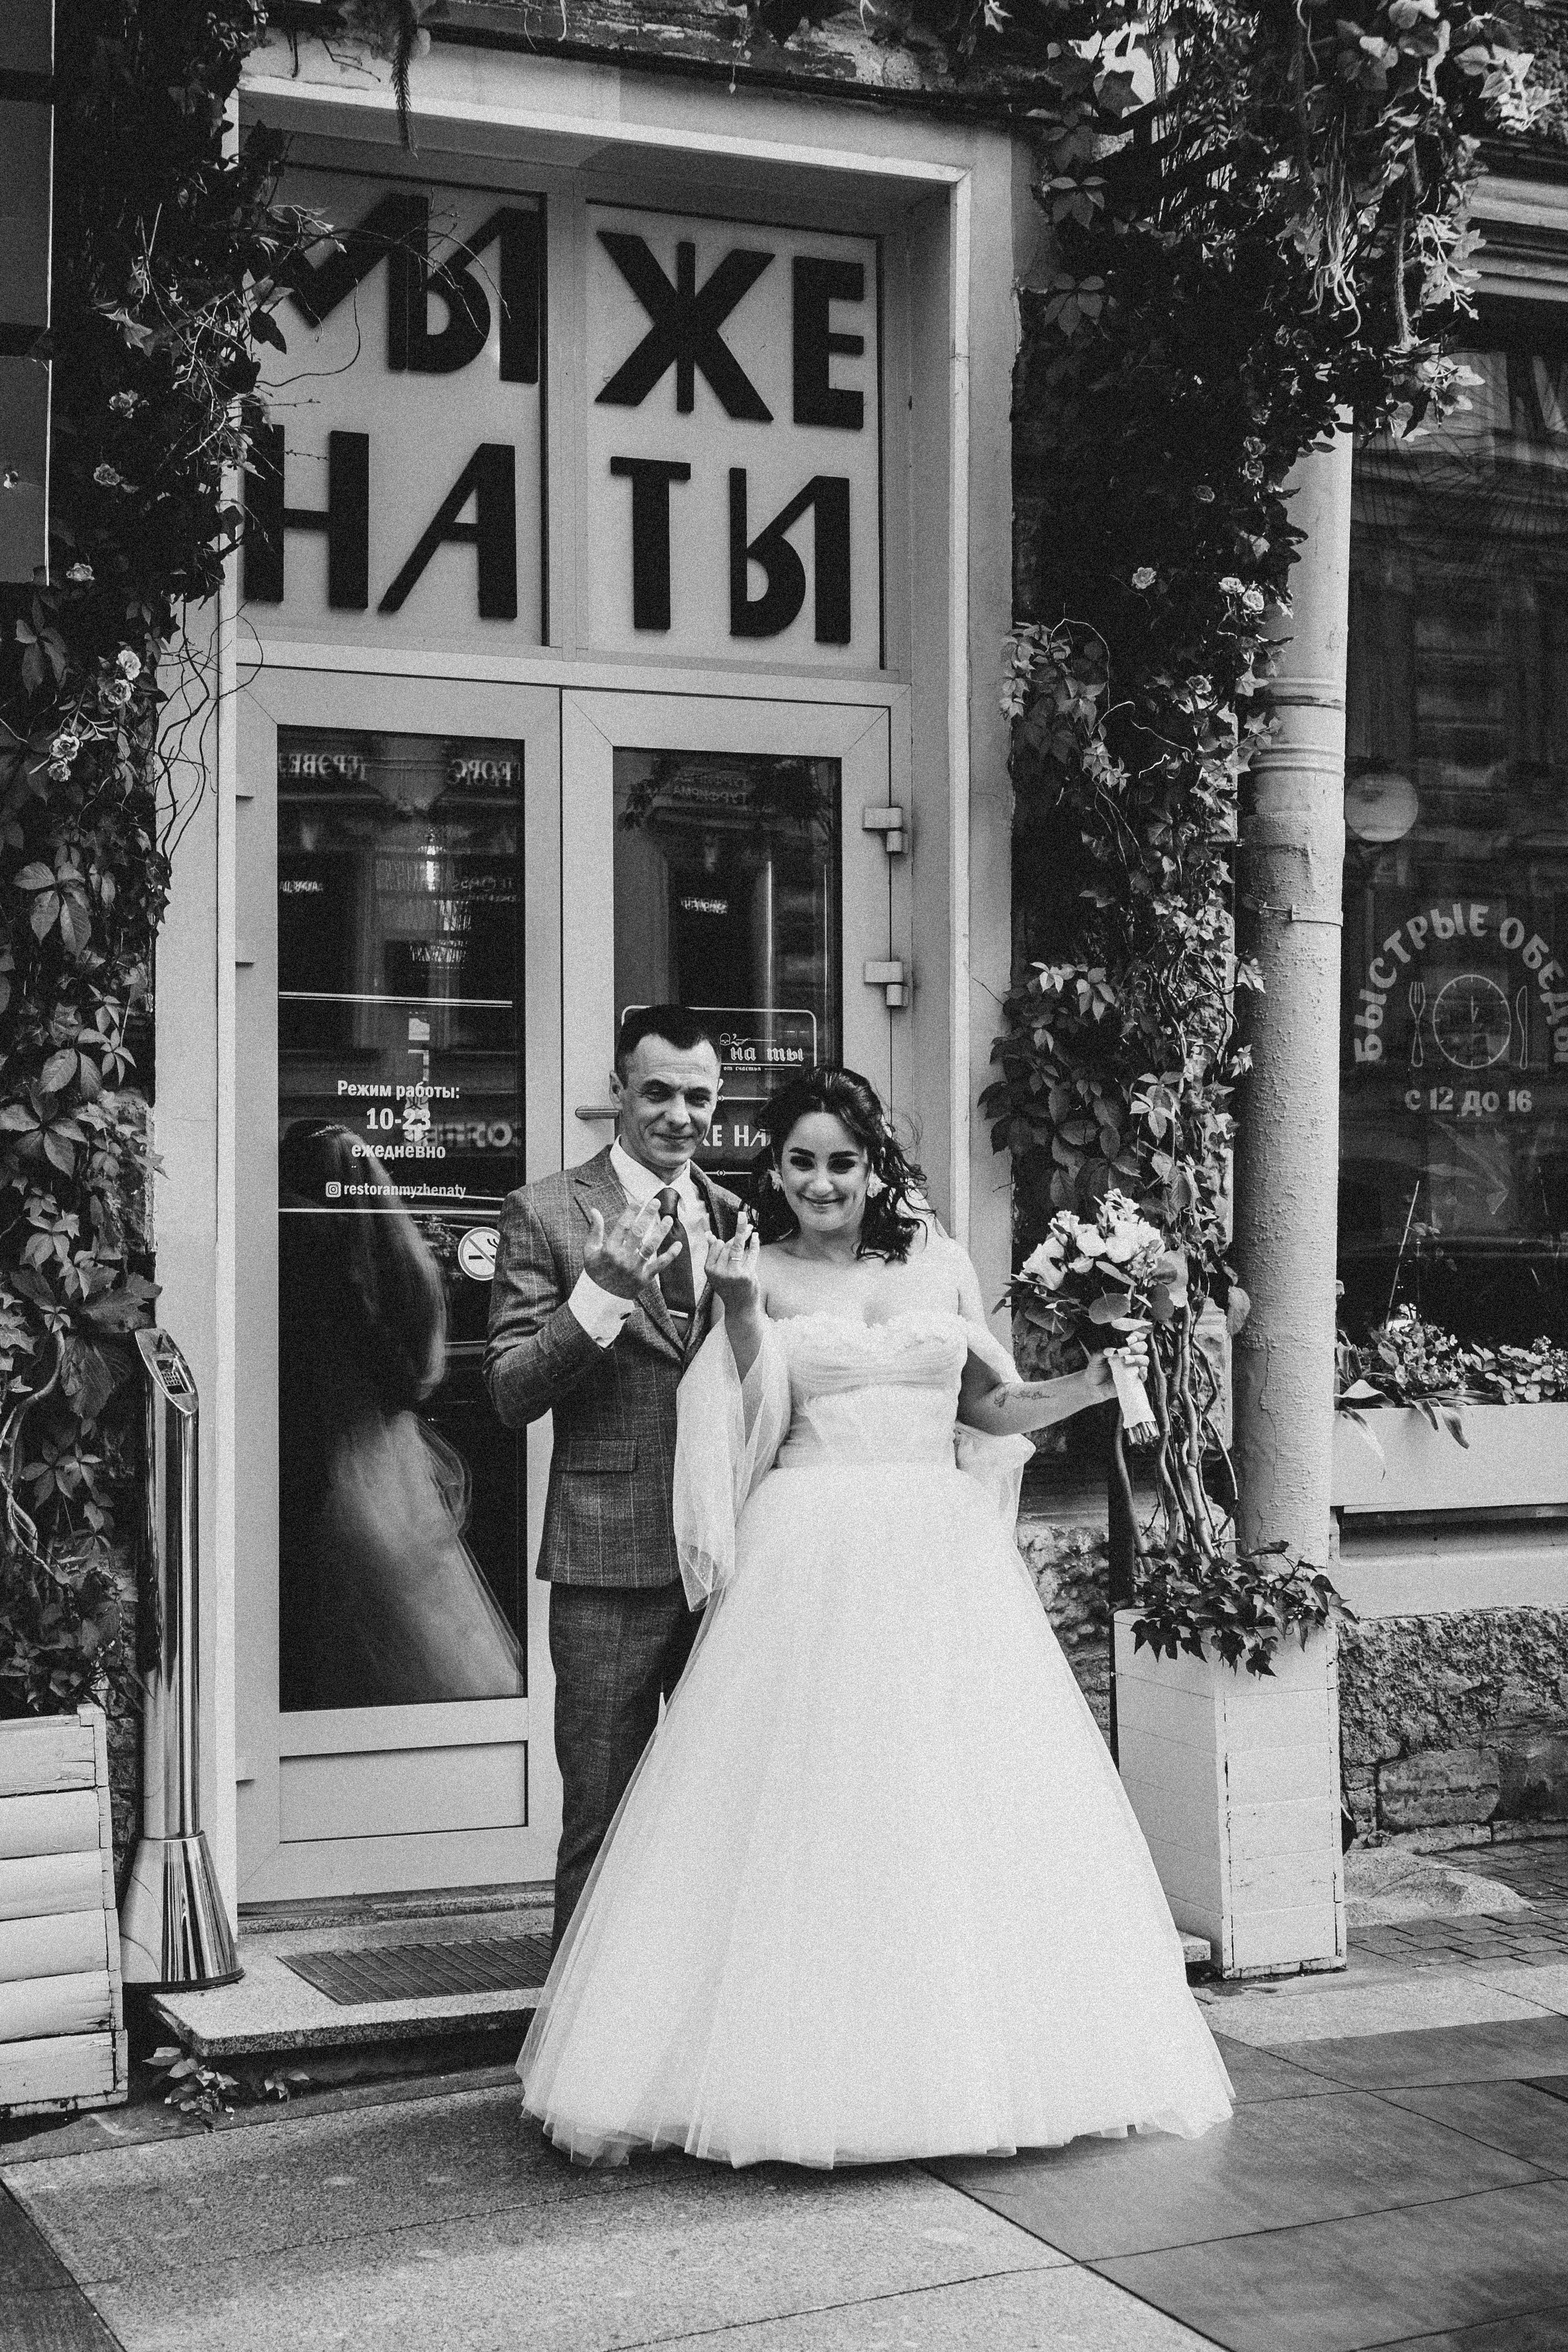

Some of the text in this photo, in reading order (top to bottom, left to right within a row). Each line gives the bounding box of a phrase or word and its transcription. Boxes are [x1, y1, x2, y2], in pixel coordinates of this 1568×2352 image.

[594, 230, 865, 430] ЖЕ
[243, 423, 851, 644] НА ТЫ
[1354, 903, 1490, 1063] БЫСТРЫЕ
[730, 1046, 804, 1062] на ты
[337, 1080, 460, 1101] Режим работы:
[1429, 1086, 1454, 1111] 12
[1507, 1088, 1532, 1113] 16
[366, 1107, 431, 1131] 10-23
[702, 1124, 723, 1147] Е
[351, 1143, 446, 1160] ежедневно
[344, 1183, 467, 1199] restoranmyzhenaty
